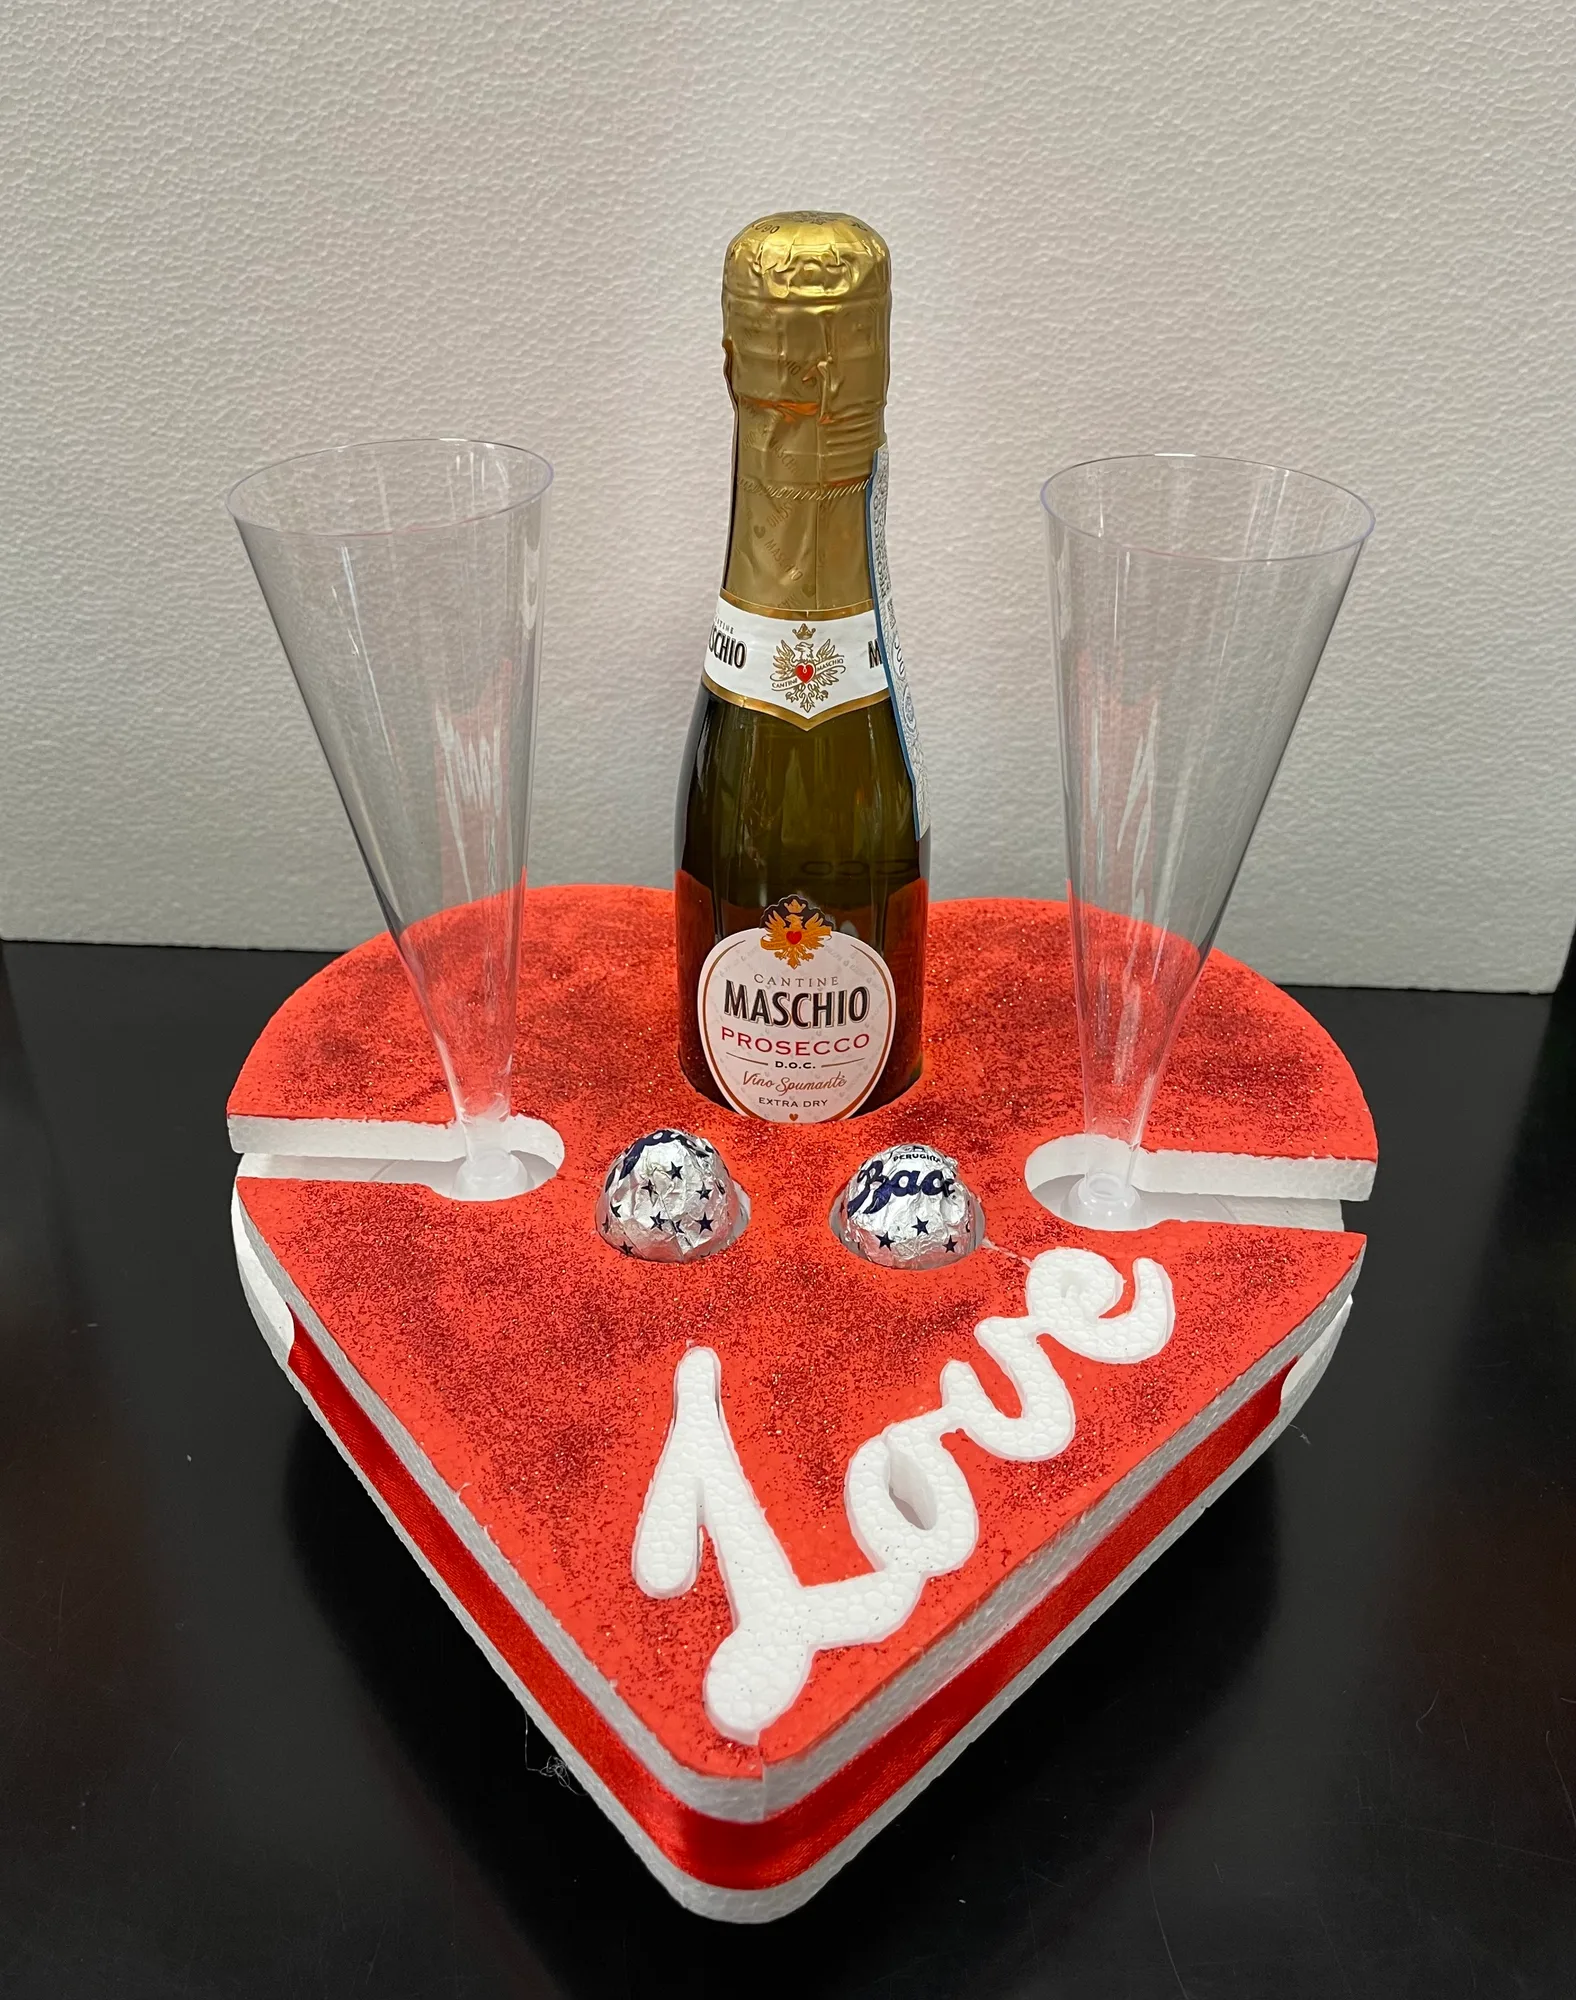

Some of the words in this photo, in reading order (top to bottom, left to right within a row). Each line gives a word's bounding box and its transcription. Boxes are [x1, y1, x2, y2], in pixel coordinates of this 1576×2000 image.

[709, 624, 747, 669] SCHIO
[816, 658, 844, 673] MASCHIO
[753, 973, 839, 987] CANTINE
[724, 979, 870, 1029] MASCHIO
[721, 1025, 870, 1056] PROSECCO
[775, 1061, 816, 1069] D.O.C.
[743, 1071, 775, 1088] Vino
[759, 1097, 798, 1108] EXTRA
[803, 1099, 828, 1108] DRY
[631, 1247, 1176, 1745] Love
